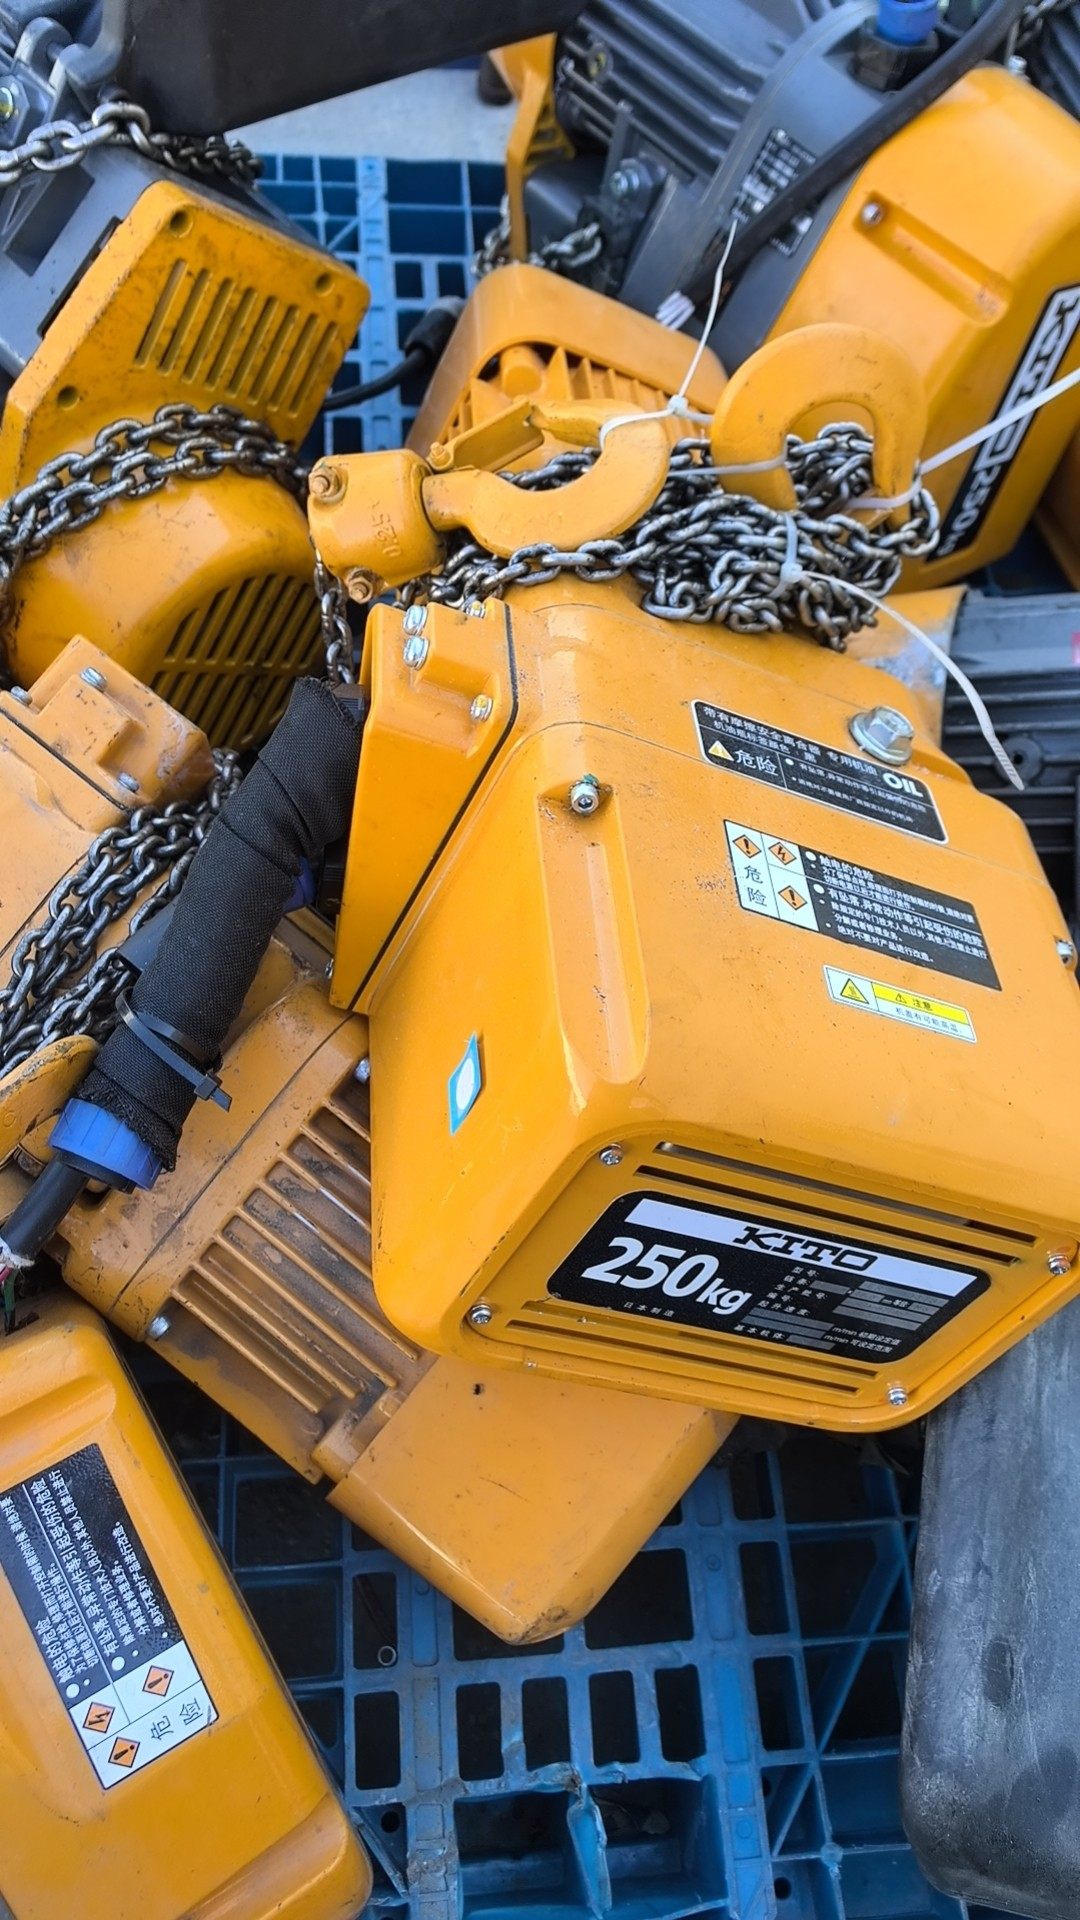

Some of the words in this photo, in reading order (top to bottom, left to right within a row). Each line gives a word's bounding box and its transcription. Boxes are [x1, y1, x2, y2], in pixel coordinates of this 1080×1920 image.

[735, 750, 778, 776] 危险
[828, 751, 878, 776] 专用机油
[883, 773, 923, 797] OIL
[819, 854, 874, 881] 触电的危险
[744, 865, 768, 908] 危险
[733, 1225, 878, 1272] KITO
[623, 1302, 675, 1318] 日本制造
[34, 1615, 76, 1684] 触电的危险
[150, 1697, 204, 1742] 危险
